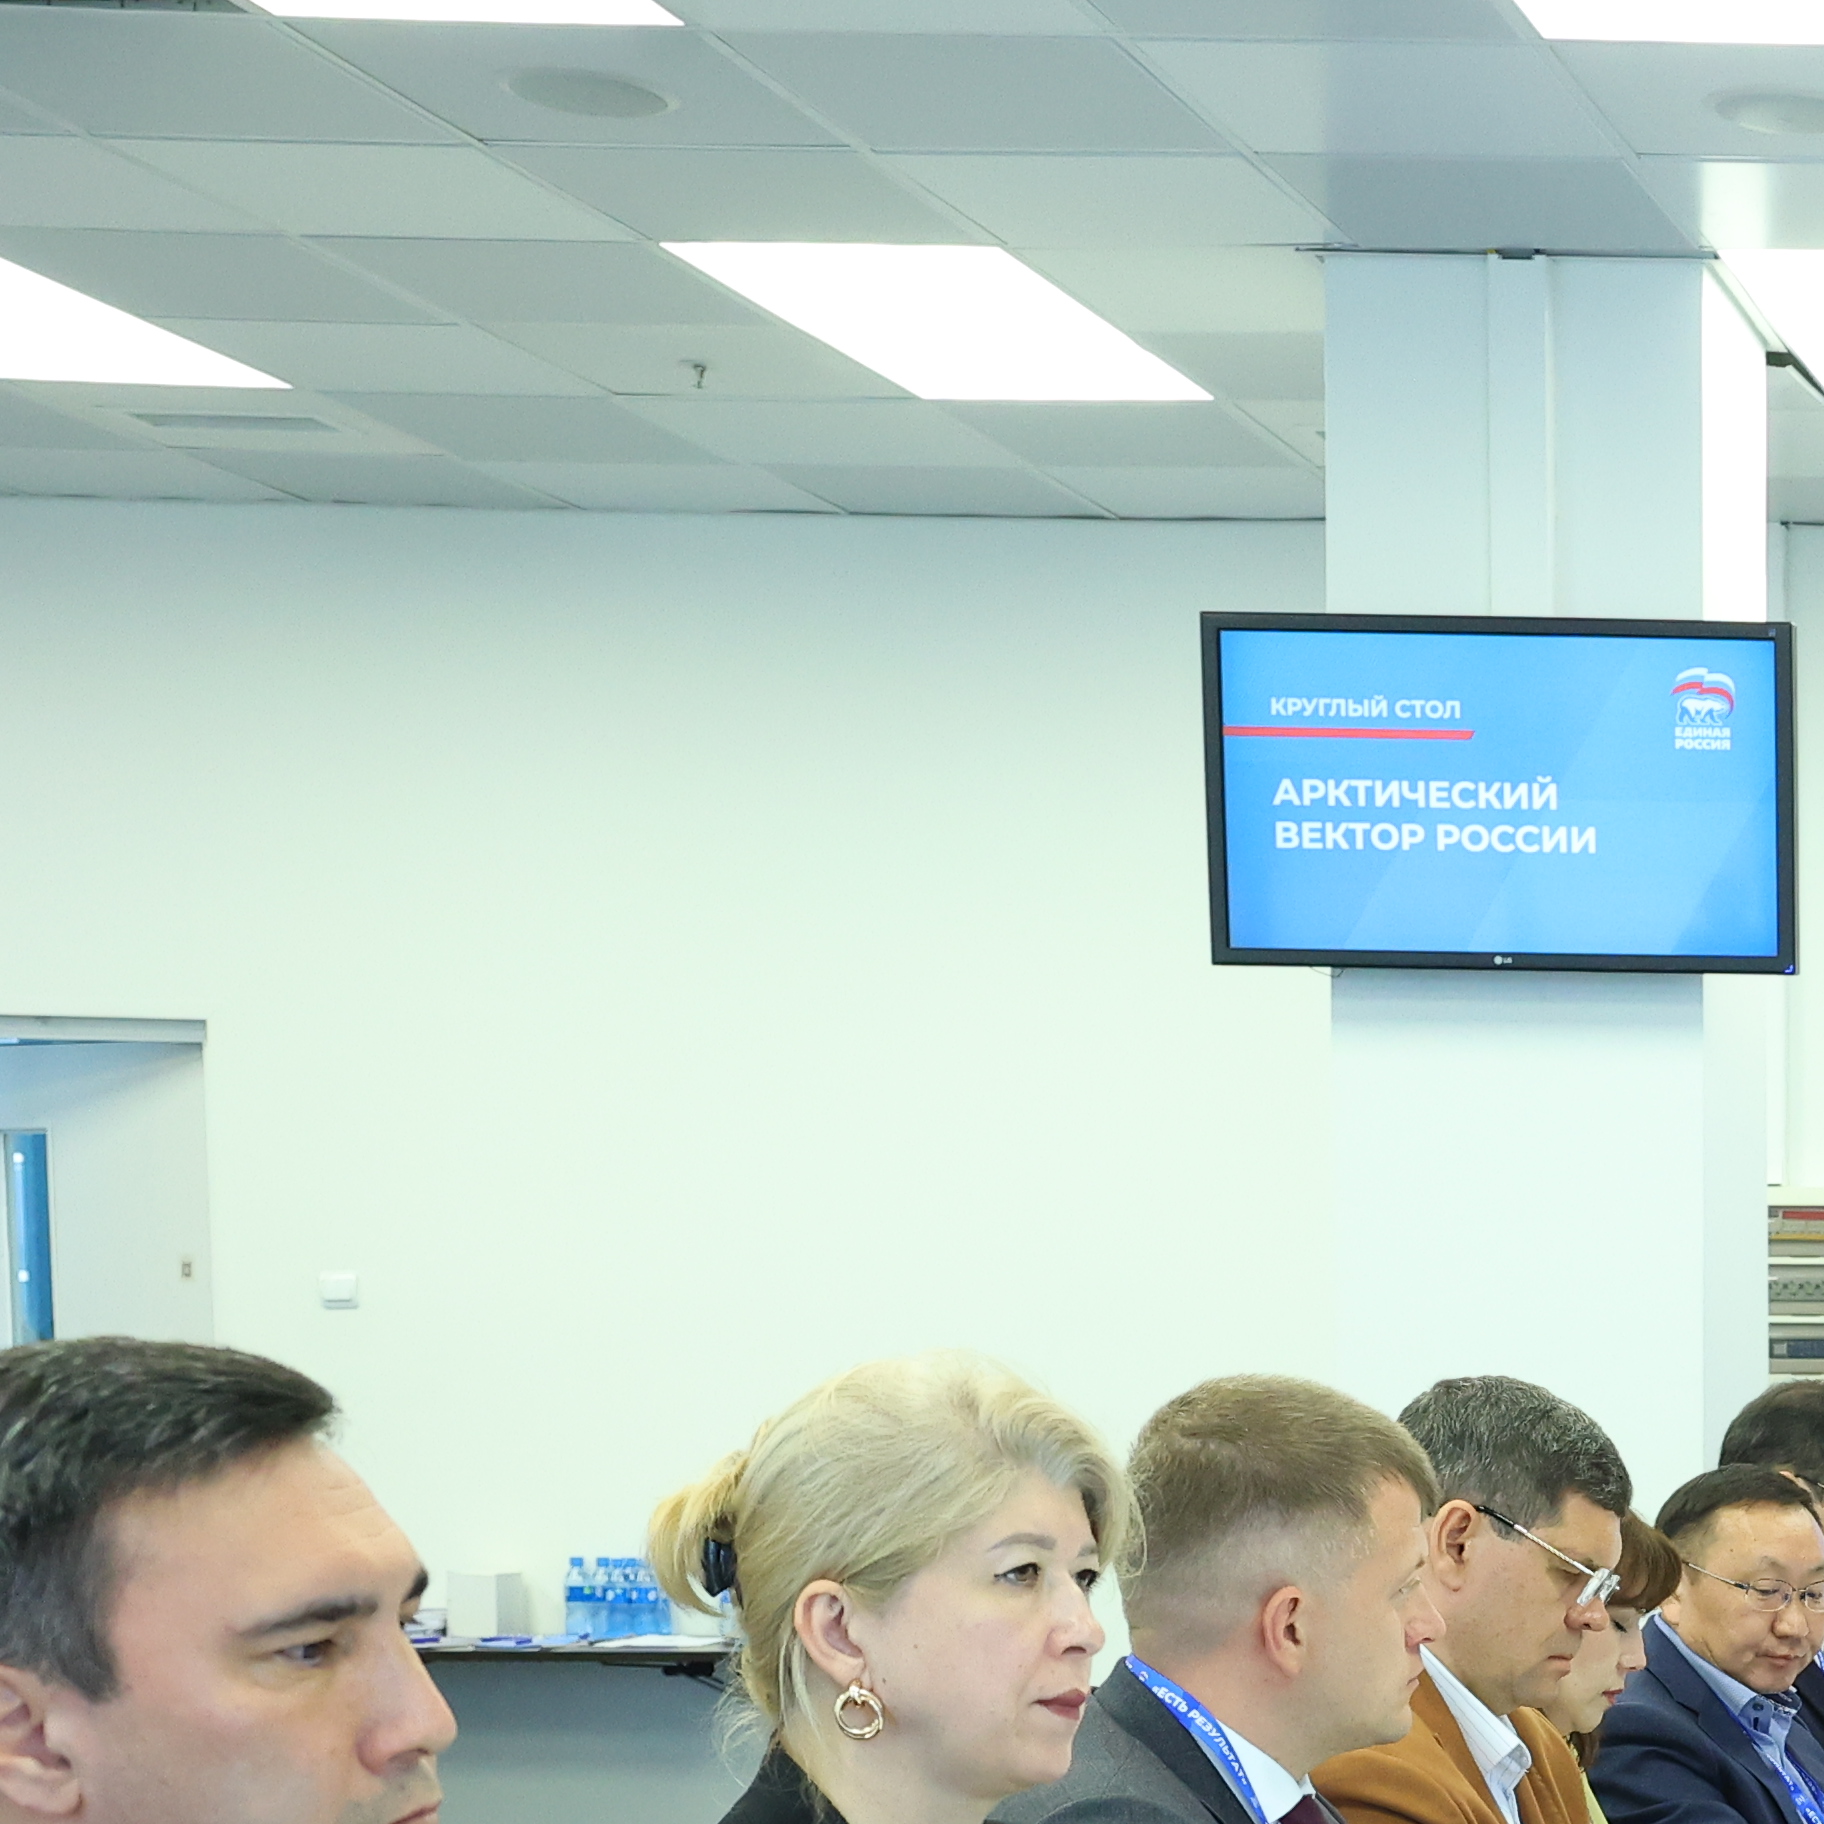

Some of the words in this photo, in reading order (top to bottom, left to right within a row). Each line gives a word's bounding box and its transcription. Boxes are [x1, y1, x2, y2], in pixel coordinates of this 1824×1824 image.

[1270, 694, 1388, 718] КРУГЛЫЙ
[1395, 698, 1461, 719] СТОЛ
[1674, 726, 1731, 739] ЕДИНАЯ
[1674, 738, 1731, 751] РОССИЯ
[1273, 776, 1558, 809] АРКТИЧЕСКИЙ
[1275, 821, 1425, 851] ВЕКТОР
[1437, 824, 1597, 854] РОССИИ
[1152, 1686, 1188, 1713] «ЕСТЬ
[1187, 1708, 1248, 1785] РЕЗУЛЬТАТ»
